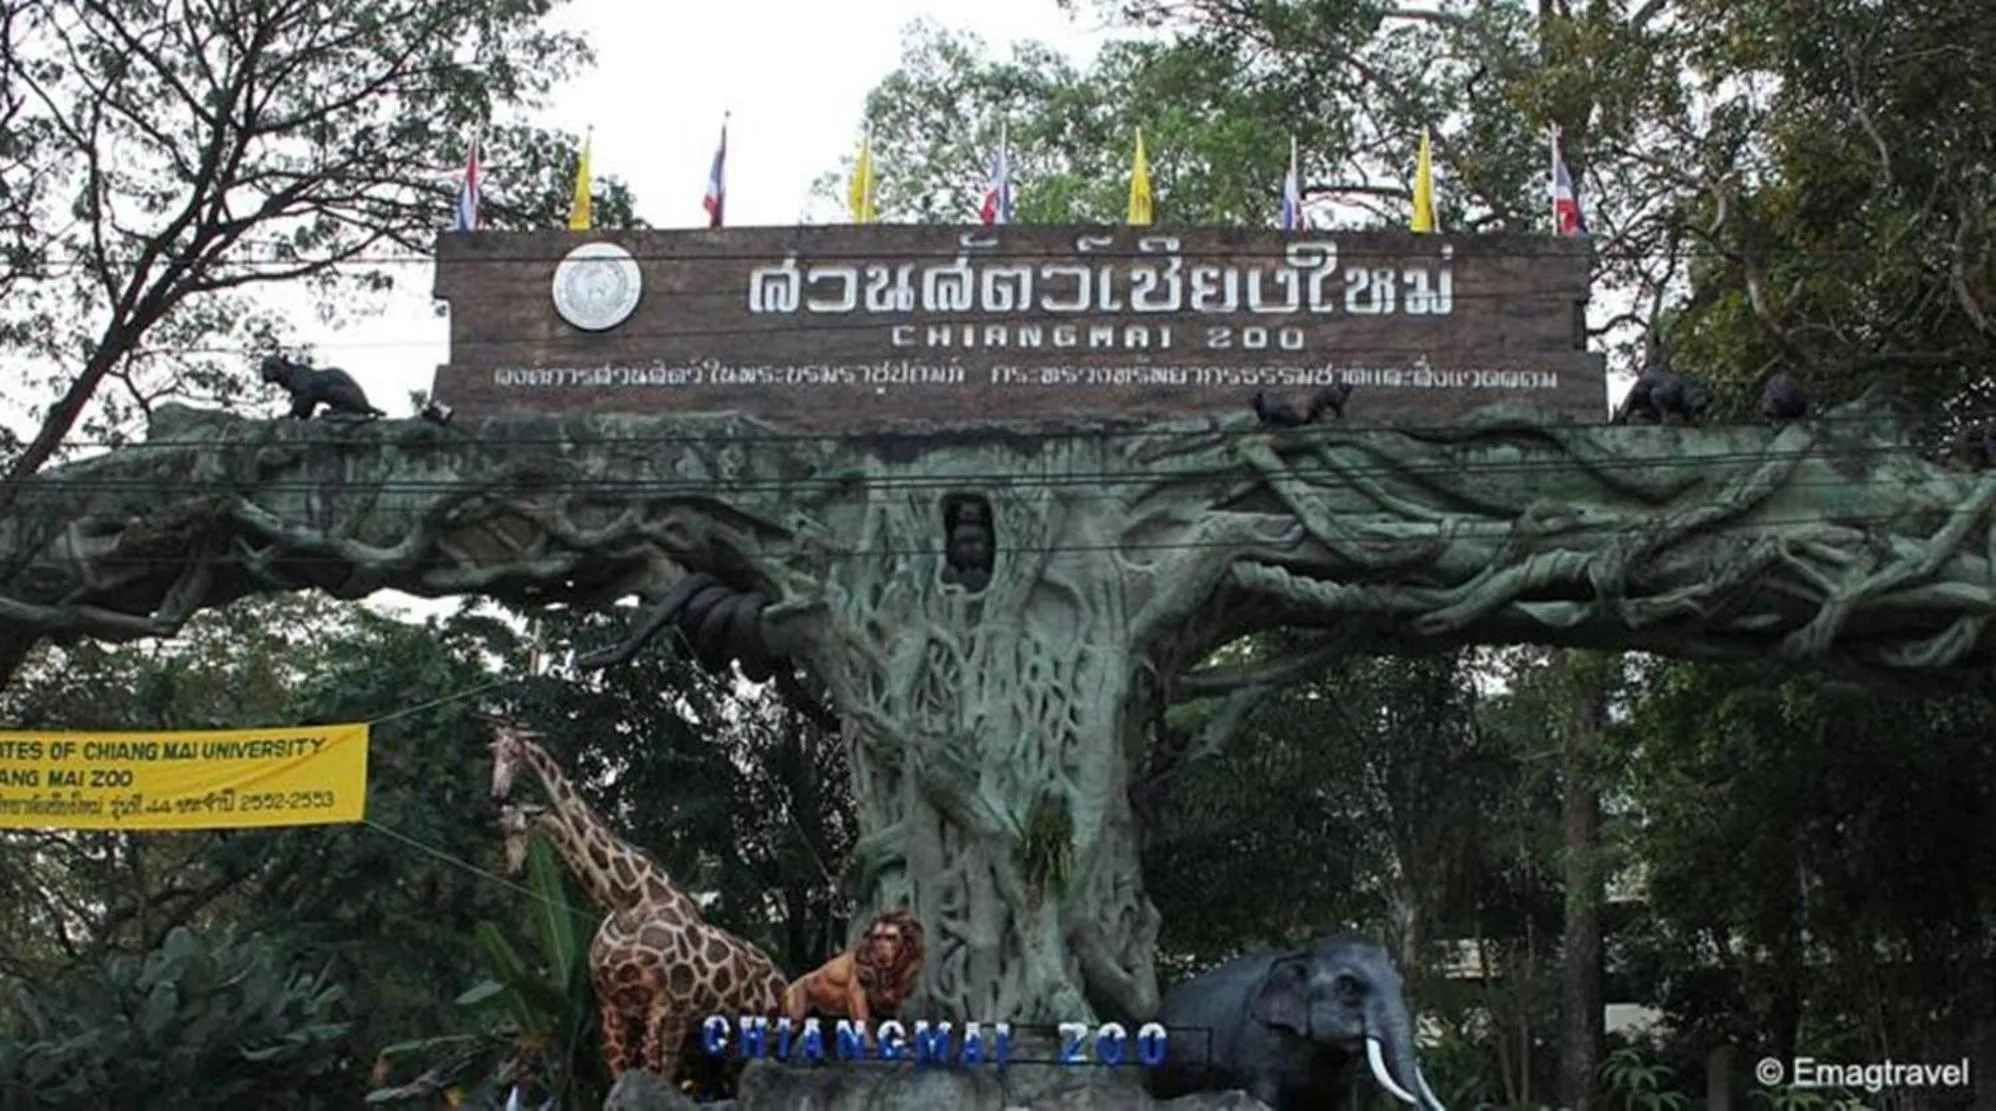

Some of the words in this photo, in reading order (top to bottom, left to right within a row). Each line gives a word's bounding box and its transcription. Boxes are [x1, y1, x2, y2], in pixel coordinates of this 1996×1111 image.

[749, 234, 1454, 315] สวนสัตว์เชียงใหม่
[892, 325, 1171, 348] CHIANGMAI
[1207, 325, 1306, 350] ZOO
[50, 741, 77, 761] OF
[83, 742, 158, 761] CHIANG
[162, 742, 198, 760] MAI
[202, 736, 328, 759] UNIVERSITY
[48, 770, 84, 787] MAI
[90, 770, 133, 787] ZOO
[239, 790, 335, 812] 2552-2553
[702, 1015, 1013, 1063] CHIANGMAI
[1058, 1022, 1170, 1066] ZOO
